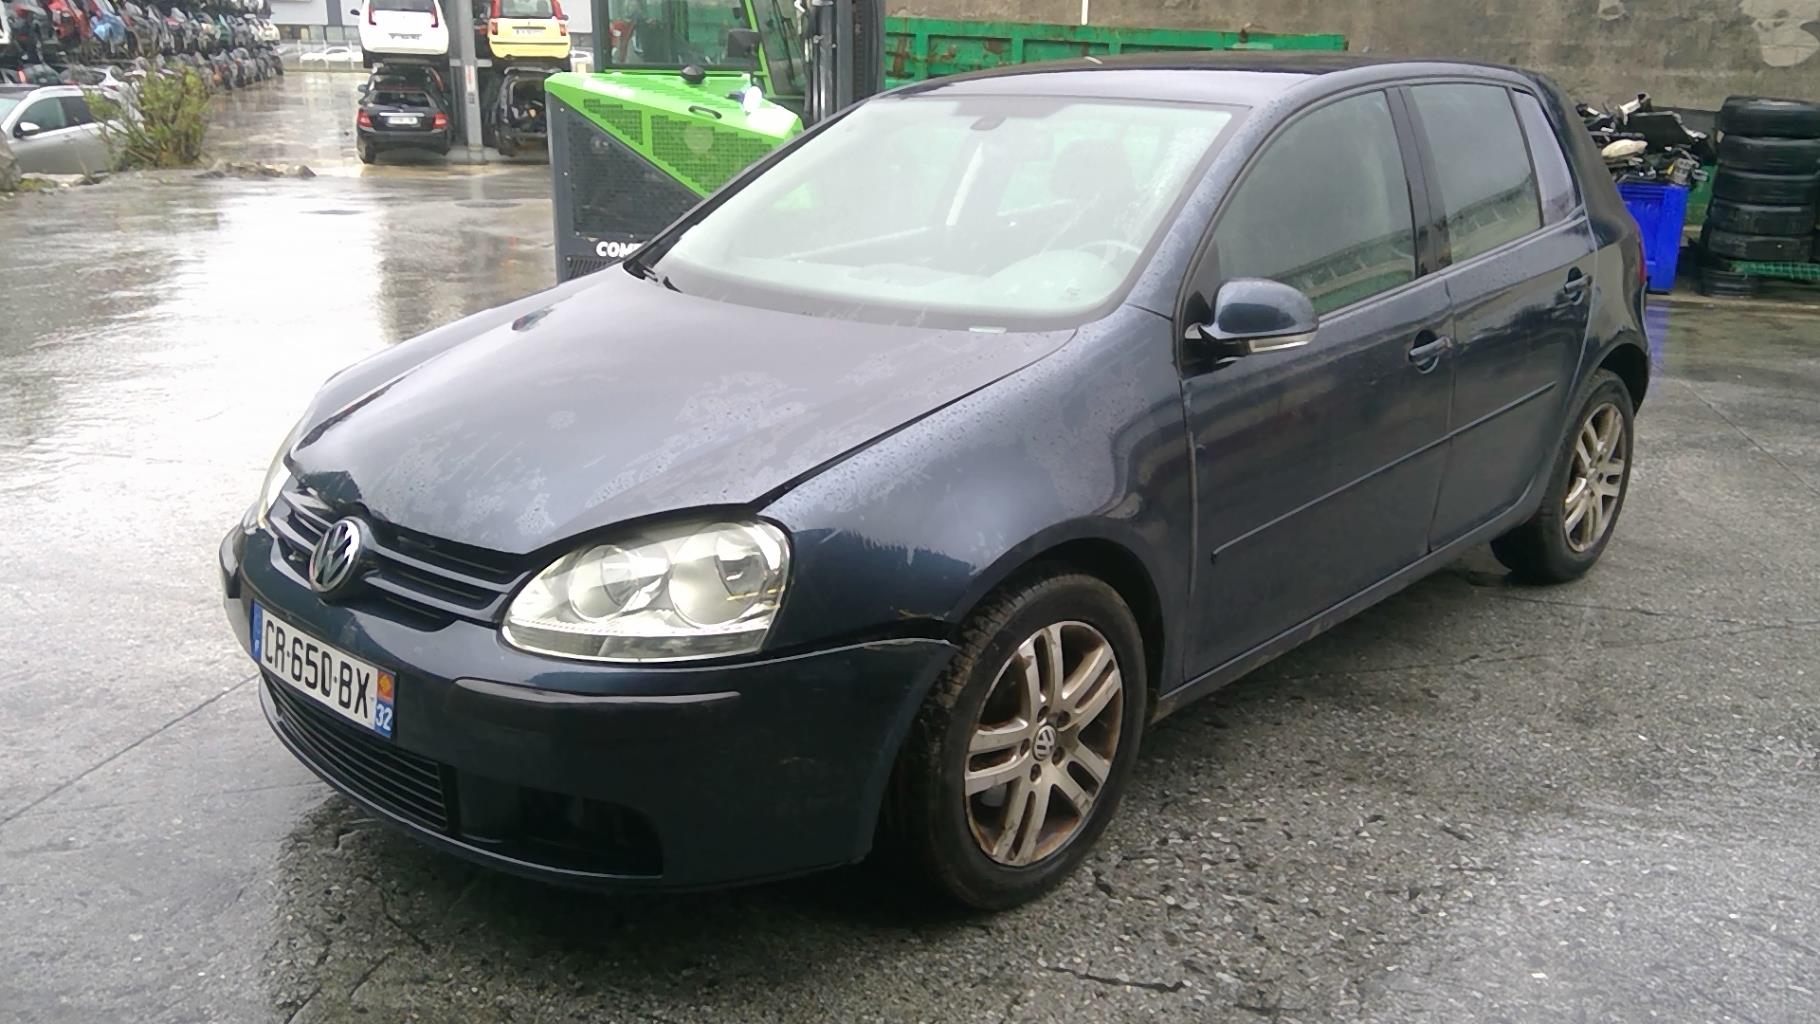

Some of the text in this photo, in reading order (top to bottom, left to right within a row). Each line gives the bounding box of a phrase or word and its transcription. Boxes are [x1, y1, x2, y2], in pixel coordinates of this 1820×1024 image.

[596, 241, 643, 257] COM
[264, 619, 370, 719] CR-650-BX
[375, 703, 393, 731] 32
